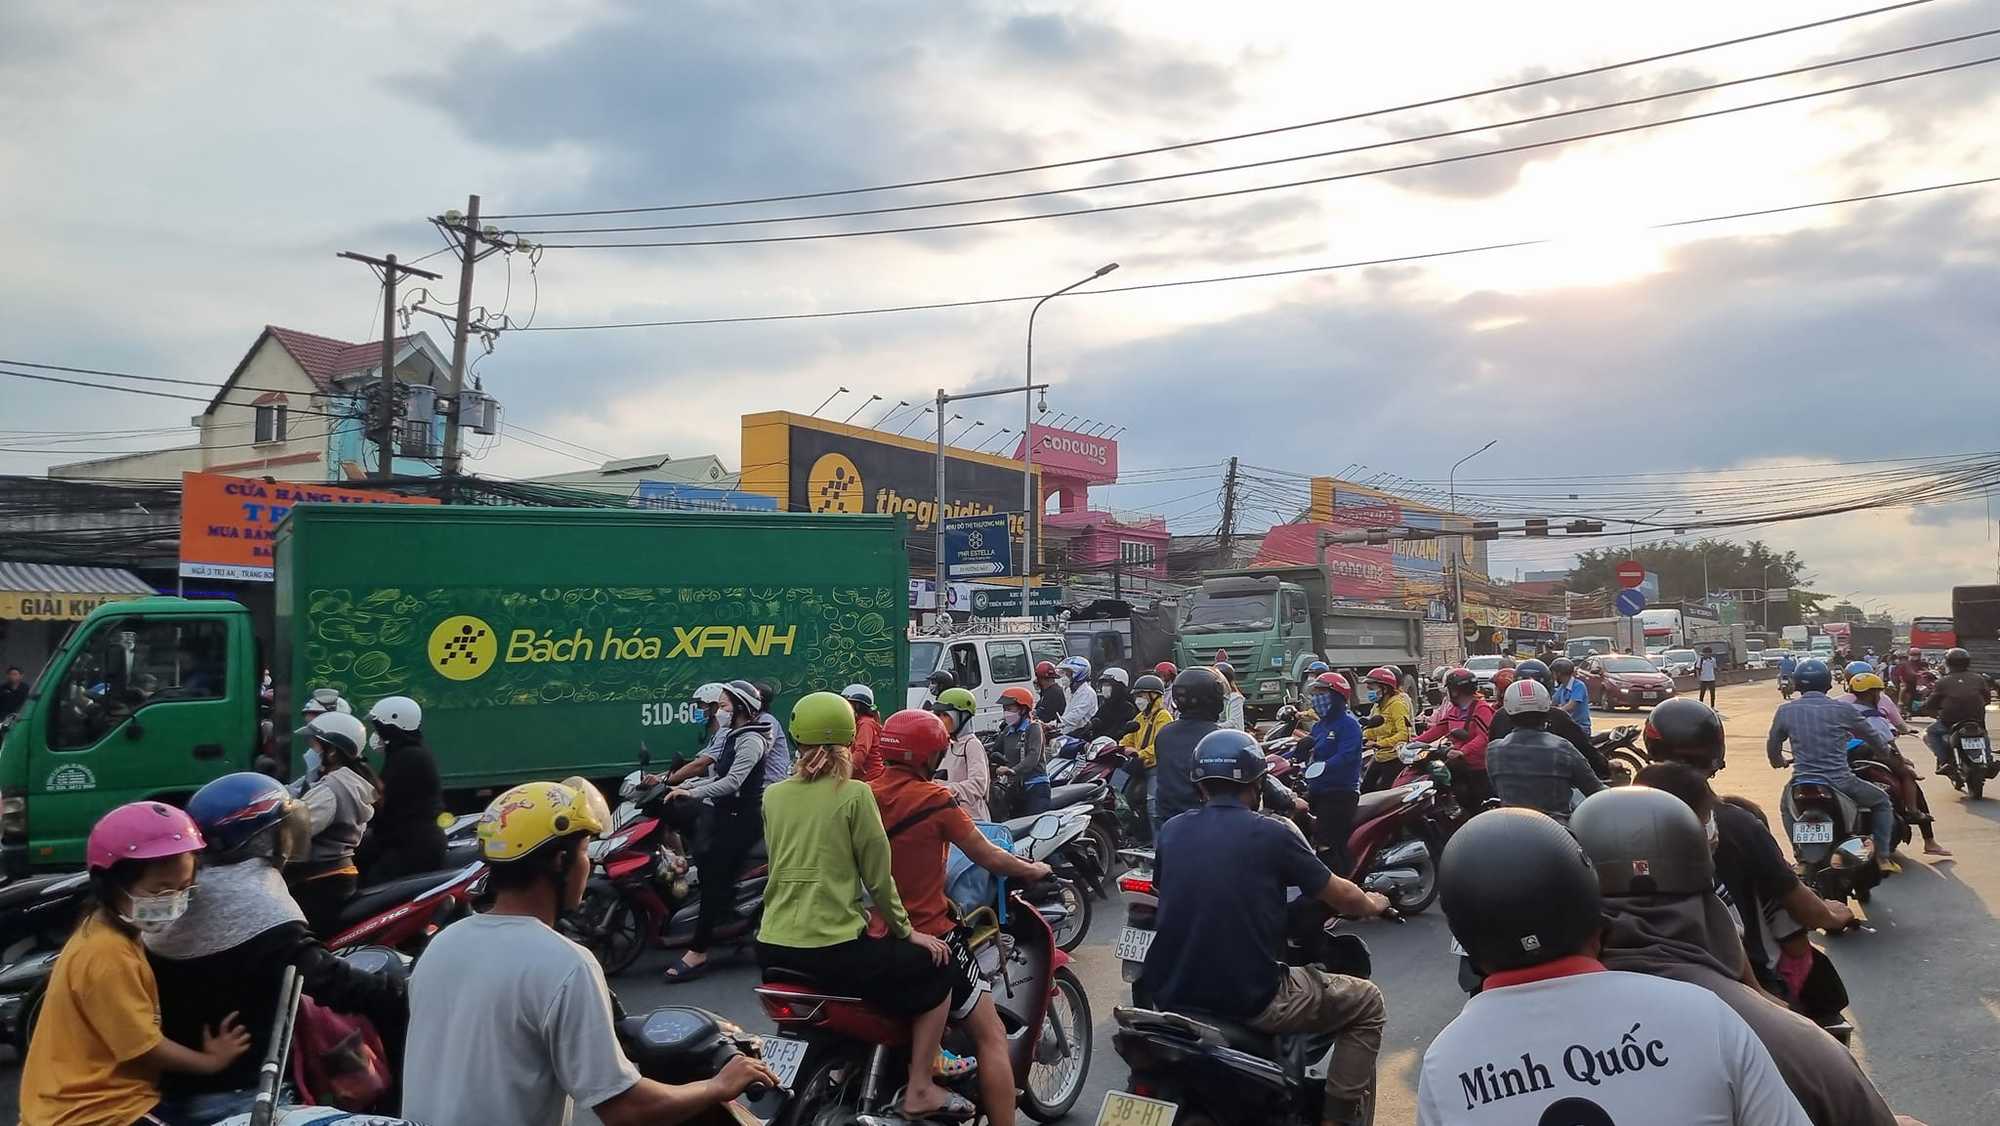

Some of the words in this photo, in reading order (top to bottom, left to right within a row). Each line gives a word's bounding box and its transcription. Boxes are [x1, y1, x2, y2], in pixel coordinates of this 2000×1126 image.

[1043, 434, 1106, 465] concung
[208, 525, 238, 539] MUA
[253, 547, 273, 557] BA
[970, 549, 996, 557] ESTELLA
[69, 596, 107, 616] KH
[505, 628, 592, 663] Bách
[600, 627, 661, 661] hóa
[667, 625, 797, 659] XANH
[1117, 943, 1145, 960] 569.1
[763, 1040, 799, 1062] 60-F3
[1458, 1052, 1555, 1110] Minh
[1563, 1022, 1669, 1085] Quốc
[1111, 1097, 1164, 1126] 38-H1
